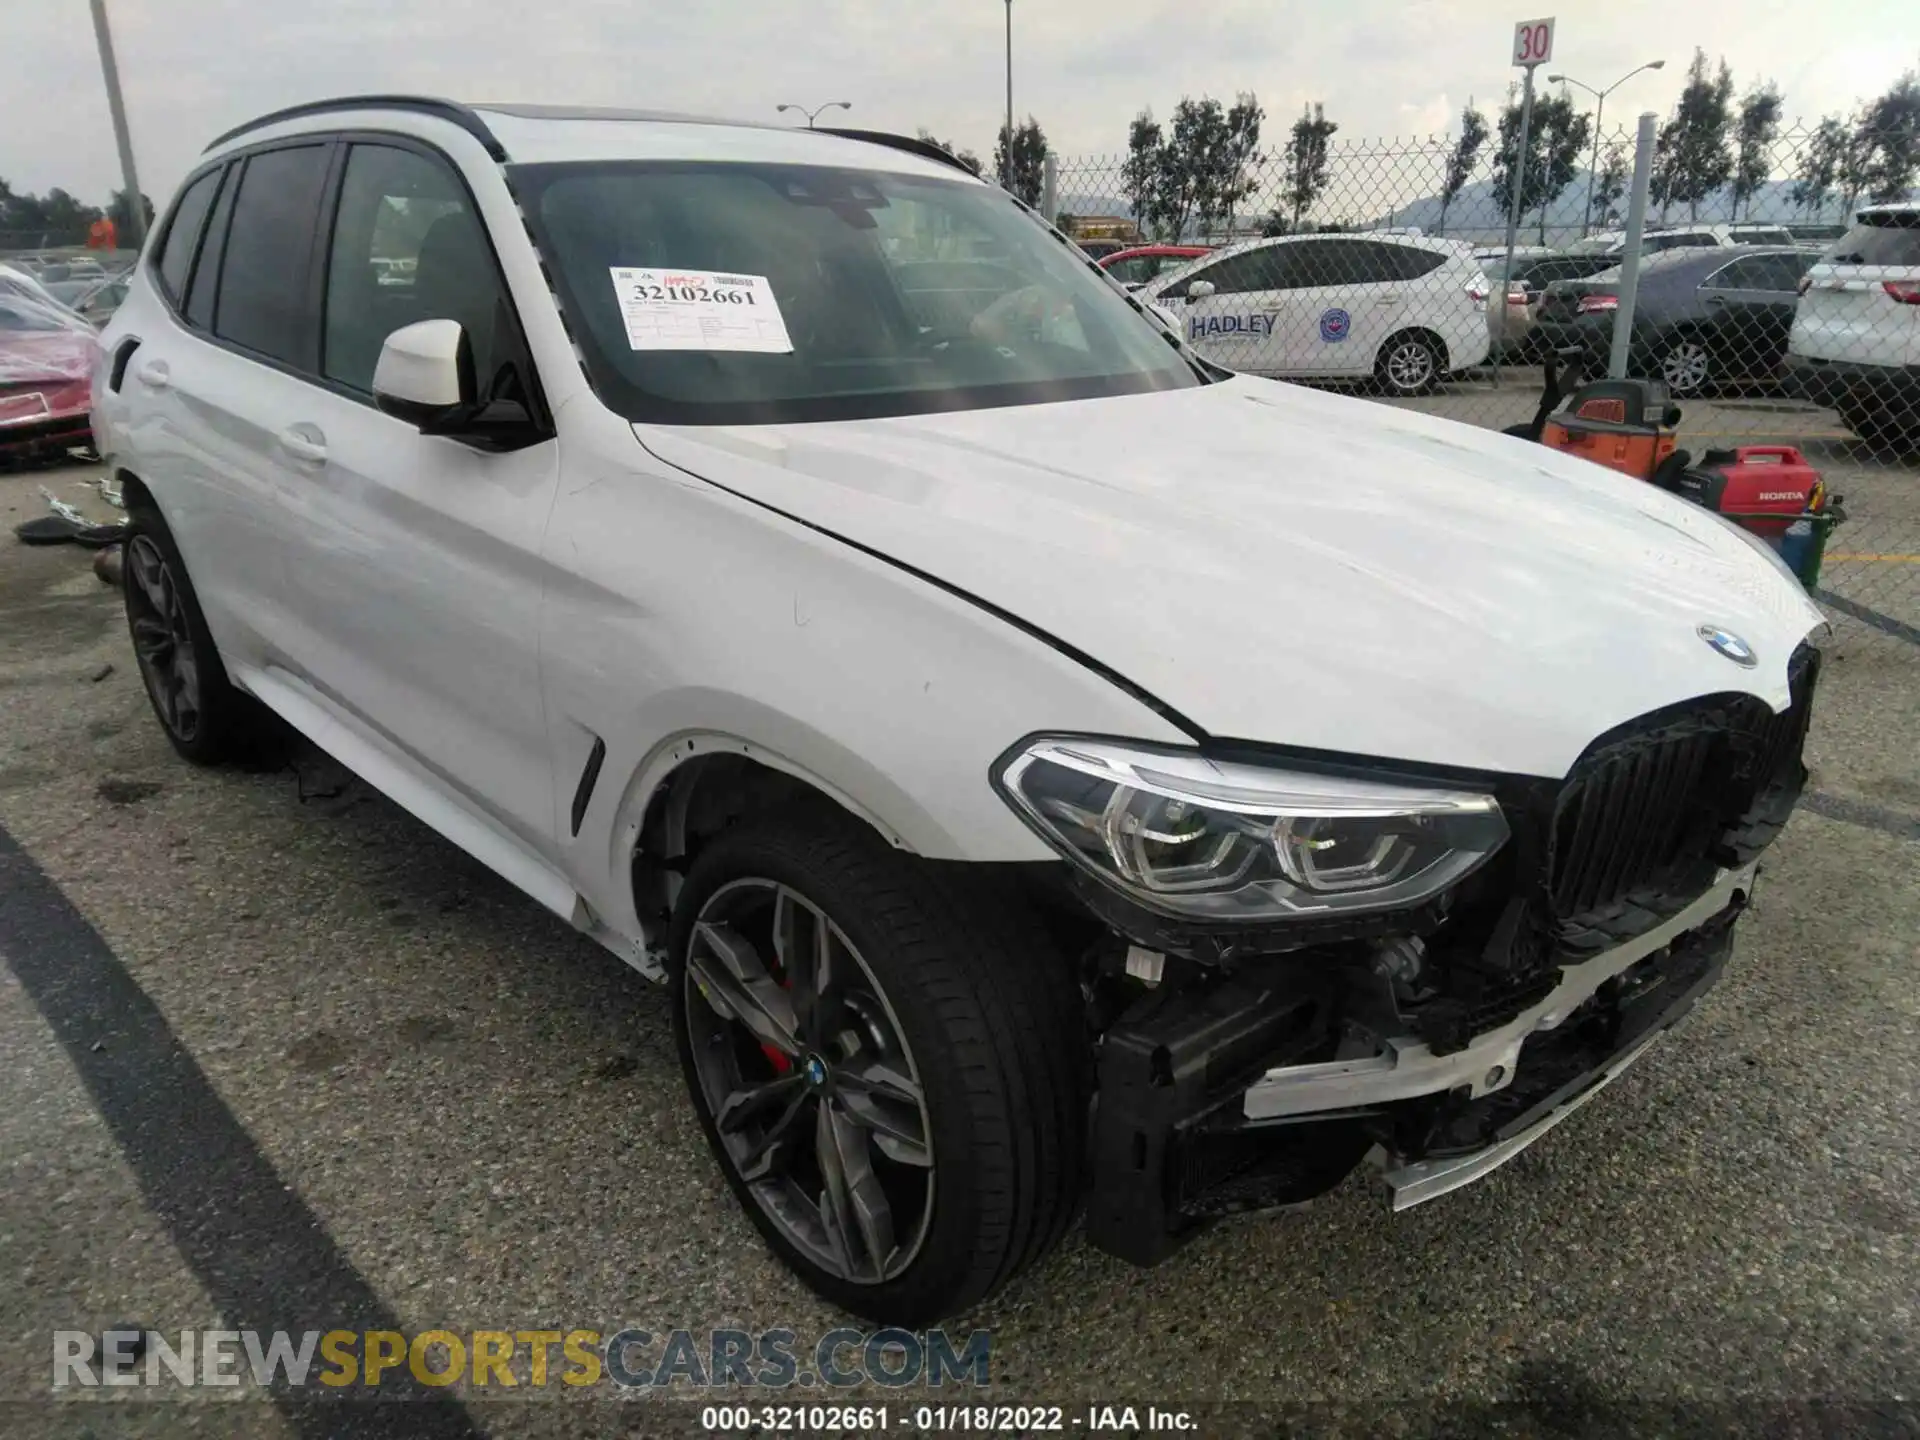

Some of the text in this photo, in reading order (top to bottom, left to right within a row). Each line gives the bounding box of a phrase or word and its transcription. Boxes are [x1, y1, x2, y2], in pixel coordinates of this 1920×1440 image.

[1517, 24, 1549, 60] 30
[633, 284, 757, 305] 32102661
[1190, 312, 1278, 339] HADLEY
[1759, 491, 1805, 501] HONDA
